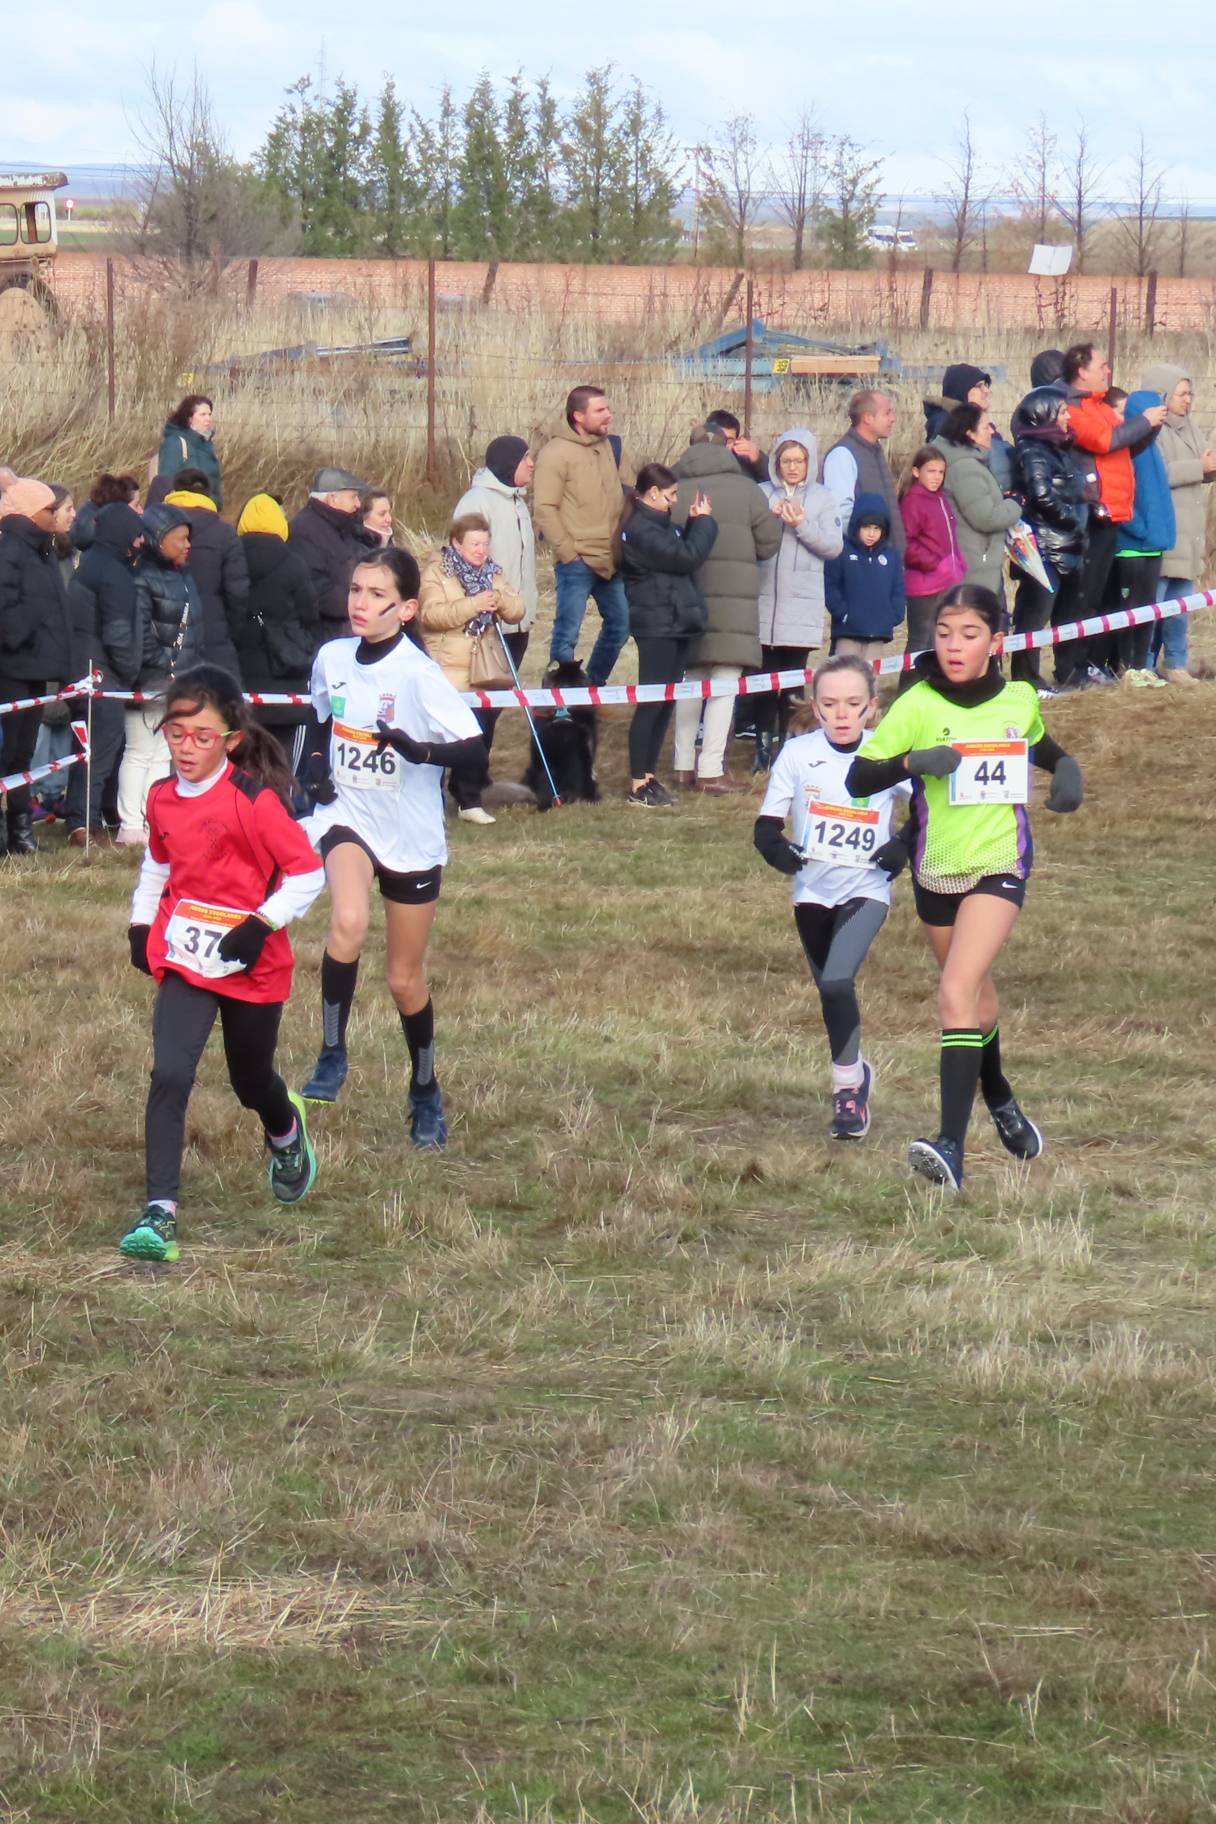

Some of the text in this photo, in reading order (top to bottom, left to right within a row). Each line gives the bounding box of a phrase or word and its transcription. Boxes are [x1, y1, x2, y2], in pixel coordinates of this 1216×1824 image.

[337, 743, 396, 774] 1246
[974, 760, 1006, 785] 44
[815, 821, 875, 851] 1249
[184, 926, 223, 958] 37
